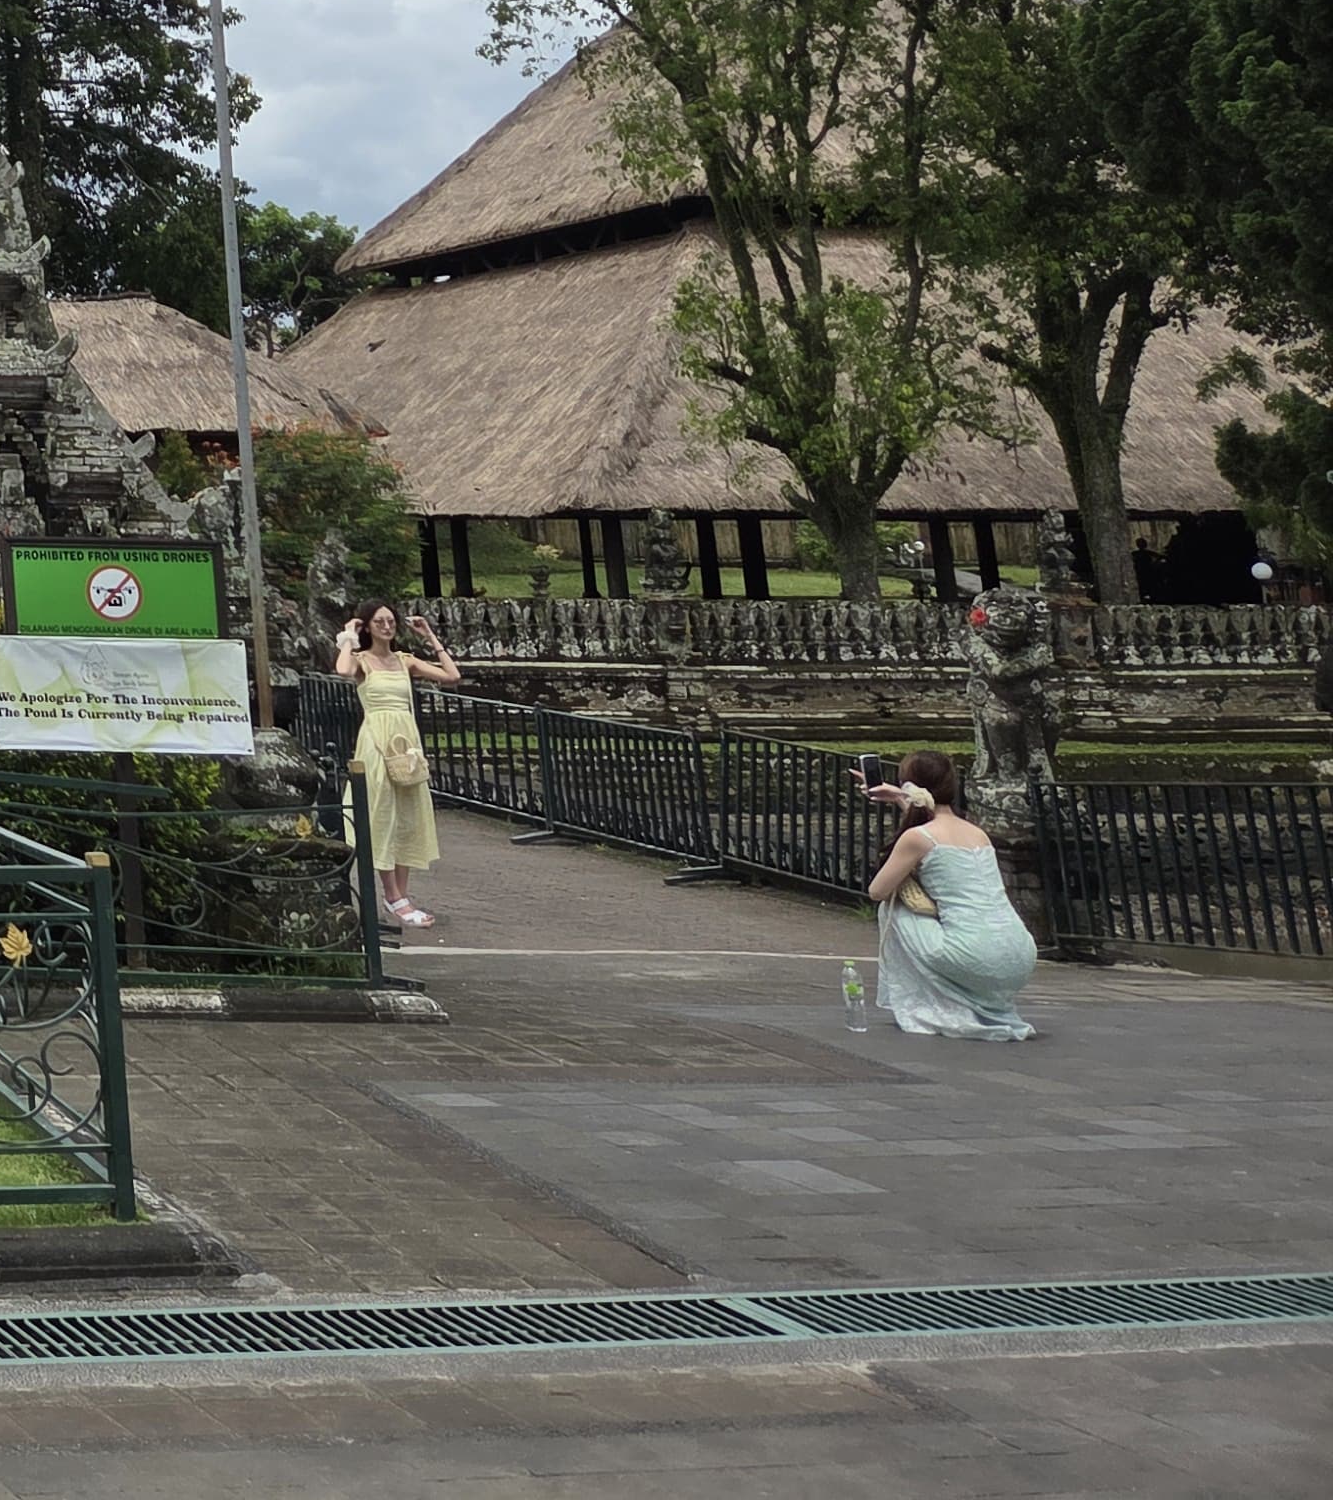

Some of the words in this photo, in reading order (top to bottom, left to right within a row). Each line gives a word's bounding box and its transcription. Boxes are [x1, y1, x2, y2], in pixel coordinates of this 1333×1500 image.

[16, 550, 84, 561] PROHIBITED
[88, 551, 120, 562] FROM
[123, 552, 159, 563] USING
[163, 552, 210, 563] DRONES
[20, 624, 60, 633] DILARANG
[62, 625, 123, 634] MENGGUNAKAN
[125, 626, 152, 635] DRONE
[154, 626, 164, 635] DI
[165, 626, 190, 636] AREAL
[192, 627, 214, 636] PURA
[20, 691, 82, 705] Apologize
[86, 693, 108, 704] For
[112, 694, 138, 705] The
[141, 695, 242, 708] Inconvenience,
[24, 707, 58, 719] Pond
[61, 708, 74, 719] Is
[78, 709, 142, 722] Currently
[146, 711, 184, 723] Being
[188, 711, 249, 724] Repaired
